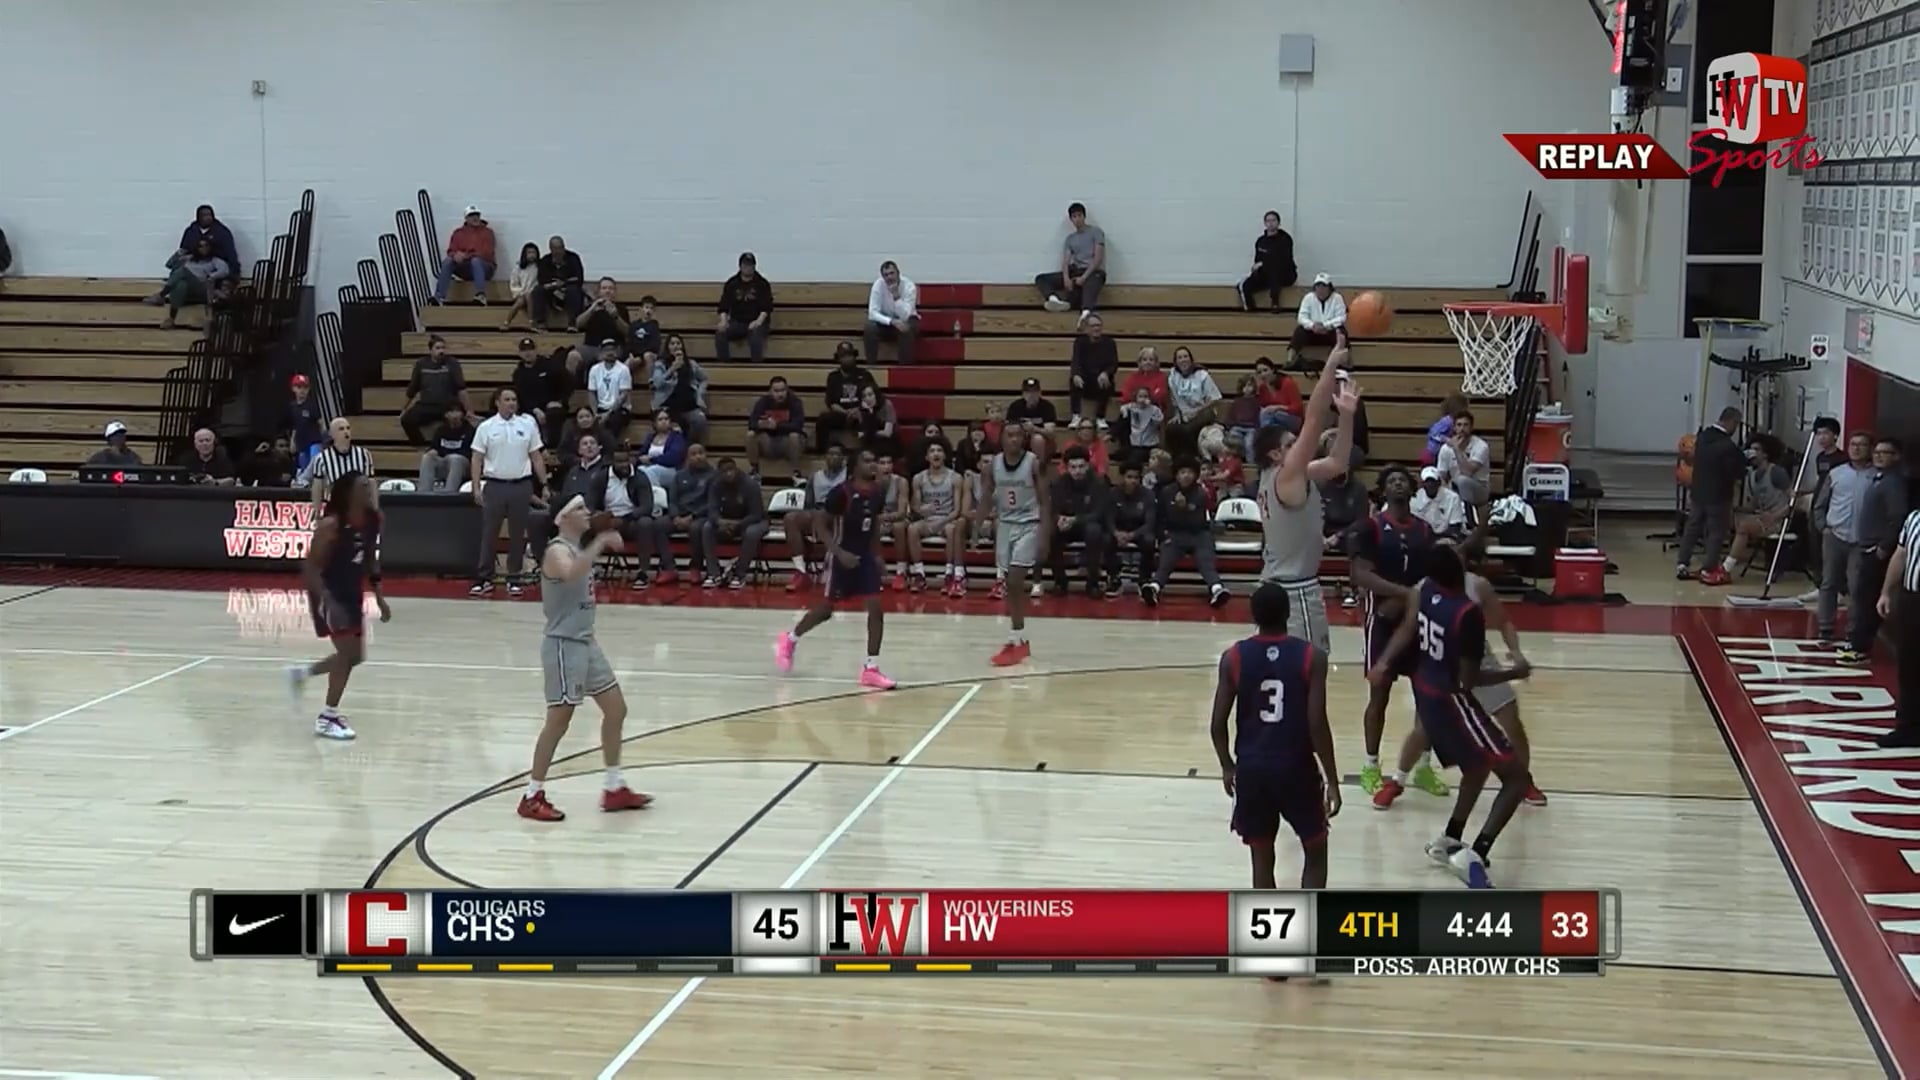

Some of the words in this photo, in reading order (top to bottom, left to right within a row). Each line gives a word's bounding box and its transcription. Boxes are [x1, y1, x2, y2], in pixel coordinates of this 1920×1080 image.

[234, 500, 320, 529] HARV
[1007, 490, 1017, 506] 3
[1417, 610, 1446, 662] 35
[1259, 679, 1285, 723] 3
